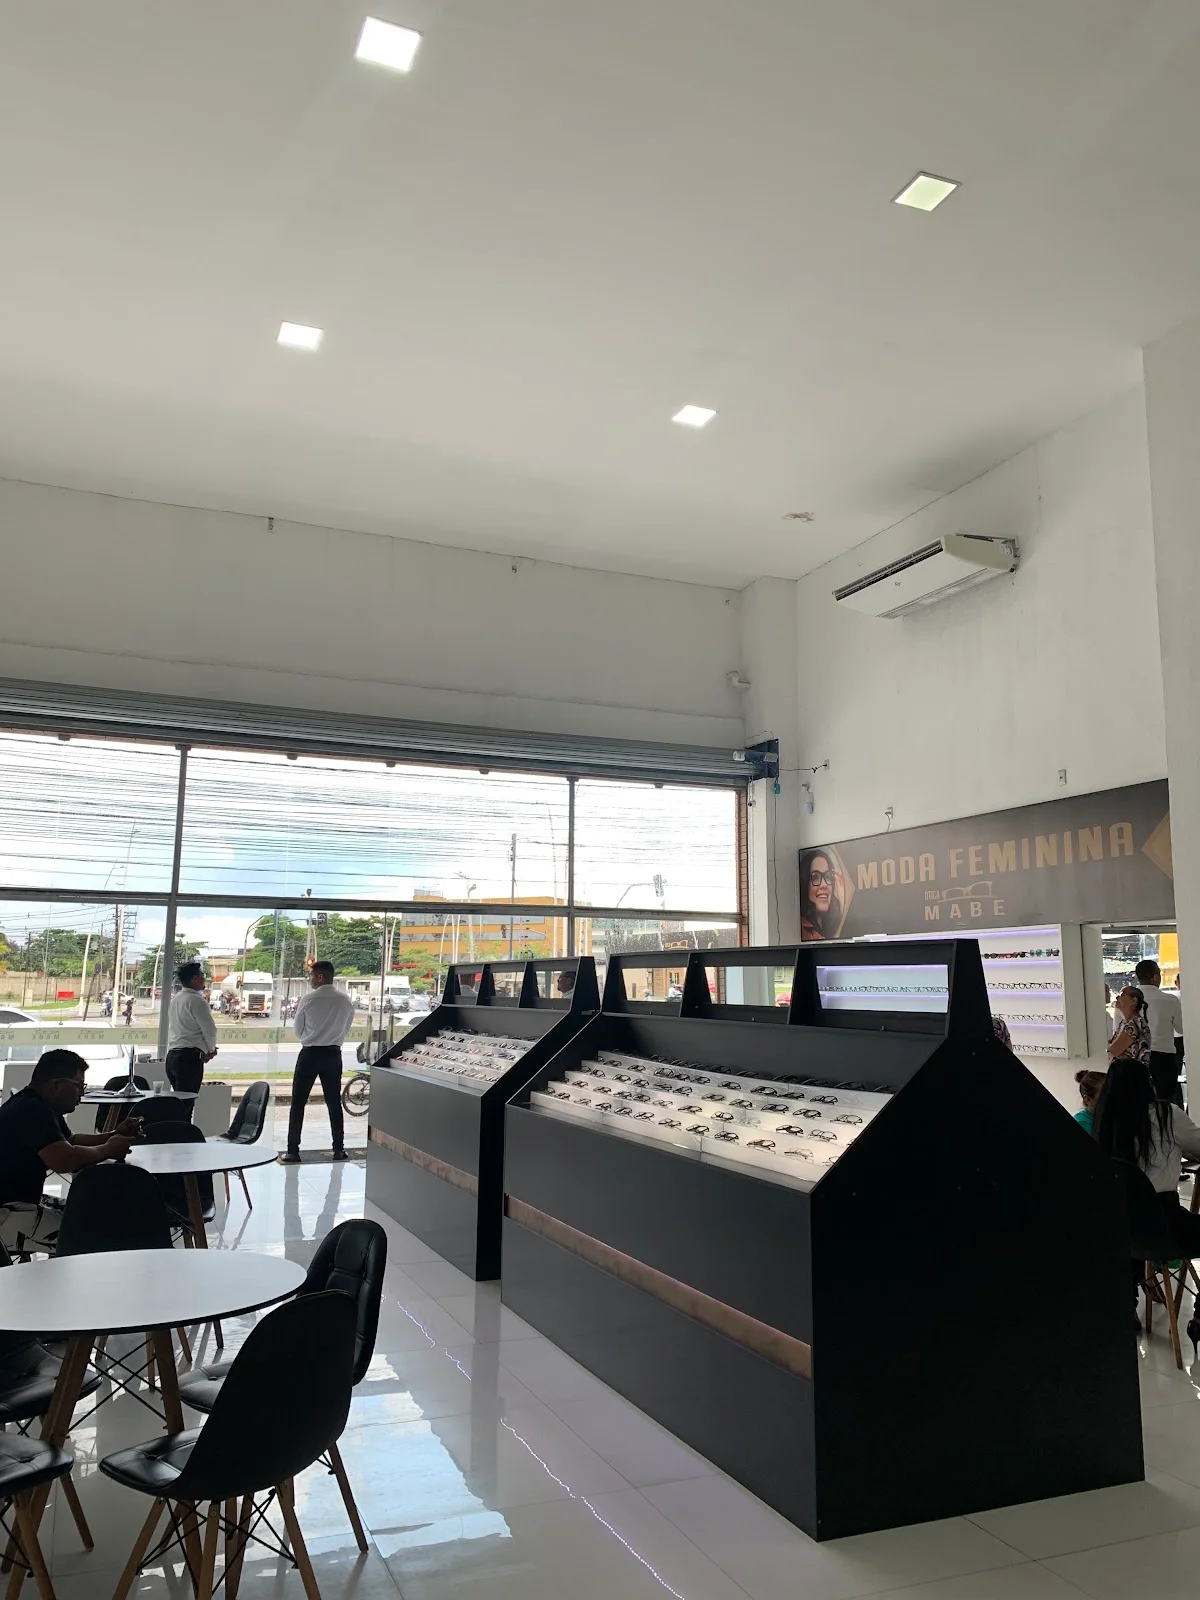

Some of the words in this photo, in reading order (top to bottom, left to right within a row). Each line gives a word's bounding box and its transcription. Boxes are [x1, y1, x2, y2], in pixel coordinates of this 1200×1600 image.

[857, 852, 936, 890] MODA
[949, 821, 1134, 878] FEMININA
[924, 889, 940, 901] ÓTICA
[924, 899, 1006, 921] MABE
